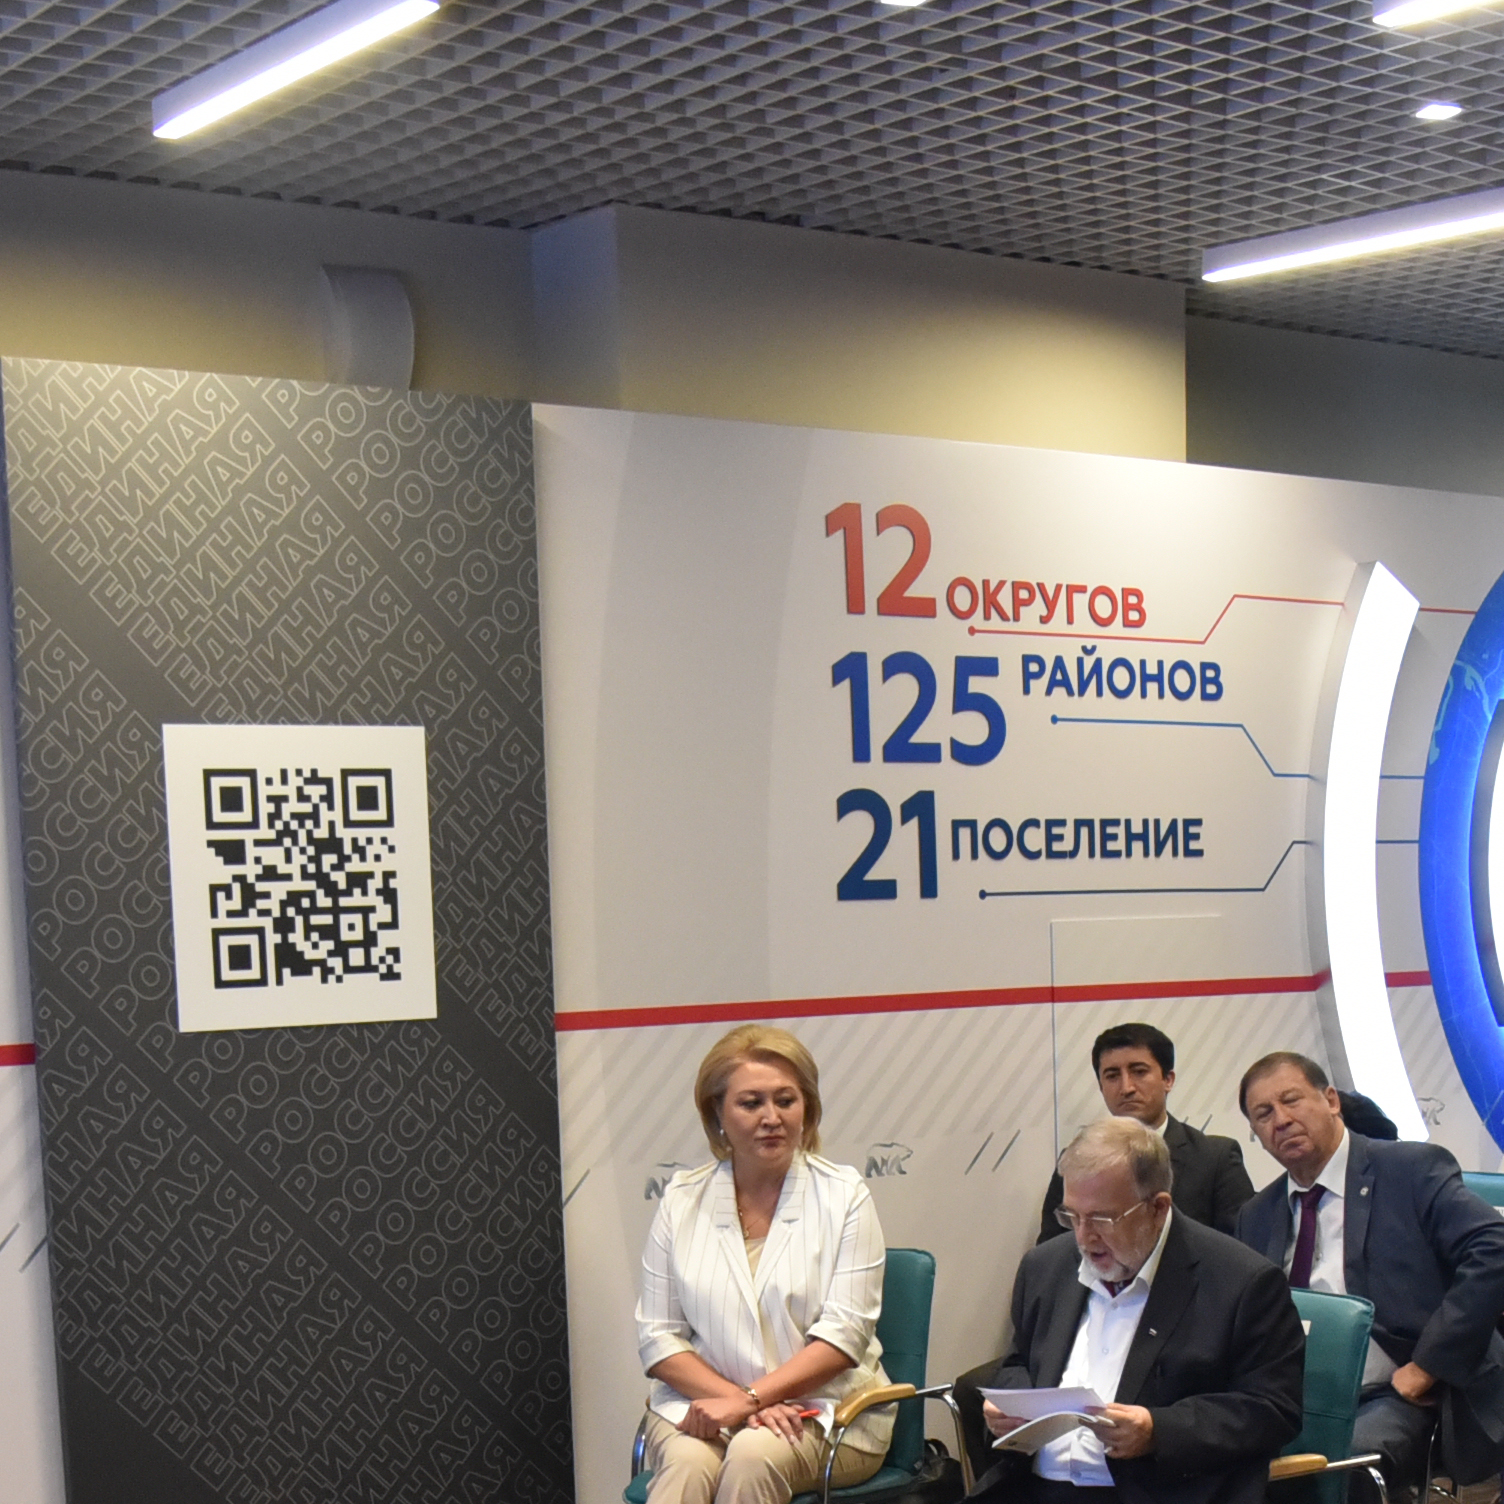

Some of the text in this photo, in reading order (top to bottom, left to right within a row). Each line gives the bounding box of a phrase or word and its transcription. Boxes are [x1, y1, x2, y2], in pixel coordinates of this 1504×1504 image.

[89, 413, 276, 627] ЕДИНАЯ
[127, 454, 311, 667] ЕДИНАЯ
[164, 494, 346, 707] ЕДИНАЯ
[824, 502, 1147, 630] 12 ОКРУГОВ
[831, 645, 1224, 767] 125 РАЙОНОВ
[836, 788, 1204, 901] 21 ПОСЕЛЕНИЕ
